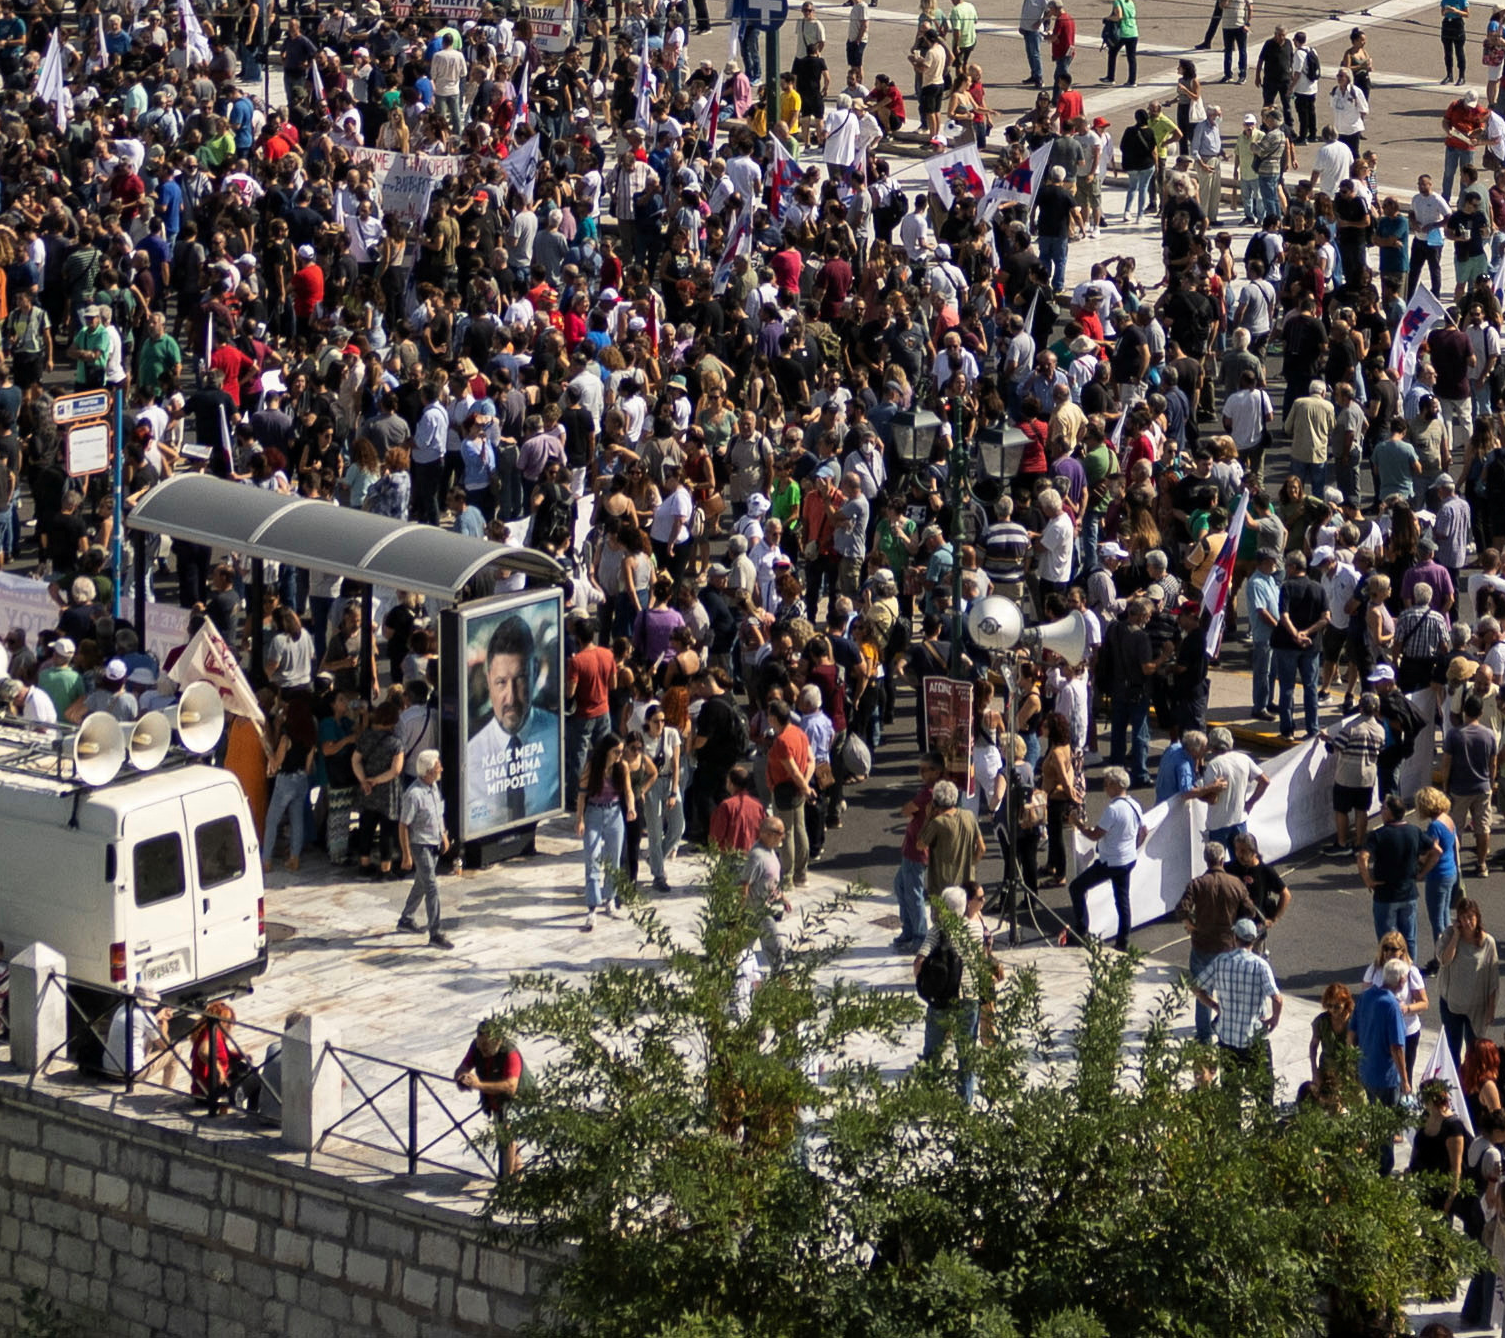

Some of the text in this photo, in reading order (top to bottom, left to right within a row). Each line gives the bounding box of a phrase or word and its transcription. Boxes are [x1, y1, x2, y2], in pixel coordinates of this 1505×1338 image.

[481, 740, 545, 767] ΚΑΘΕ ΜΕΡΑ
[484, 755, 542, 784] ΕΝΑ ΒΗΜΑ
[486, 770, 540, 796] ΜΠΡΟΣΤΑ
